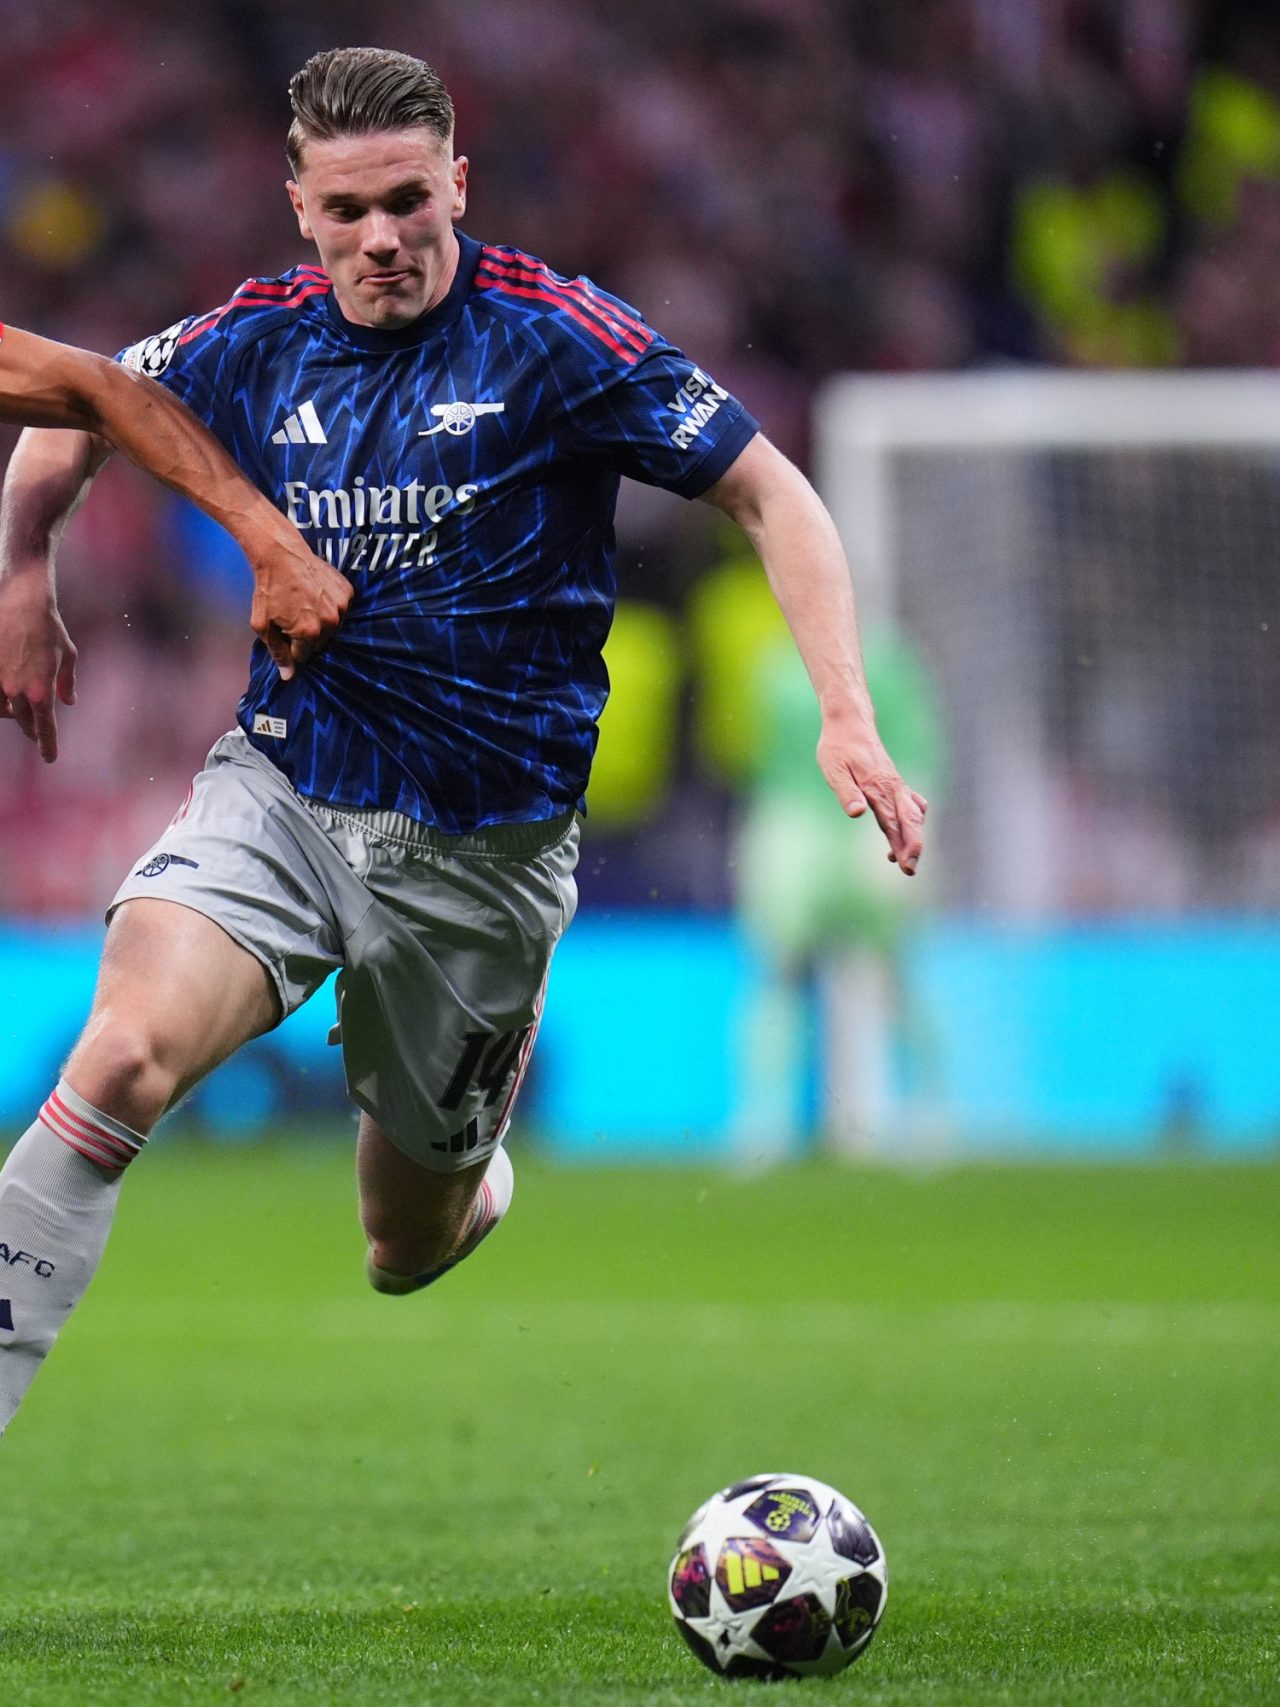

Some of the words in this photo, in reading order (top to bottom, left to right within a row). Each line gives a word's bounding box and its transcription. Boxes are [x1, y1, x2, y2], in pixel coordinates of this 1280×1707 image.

[670, 383, 729, 450] RWAN
[284, 476, 479, 530] Emirates
[436, 1026, 531, 1112] 14
